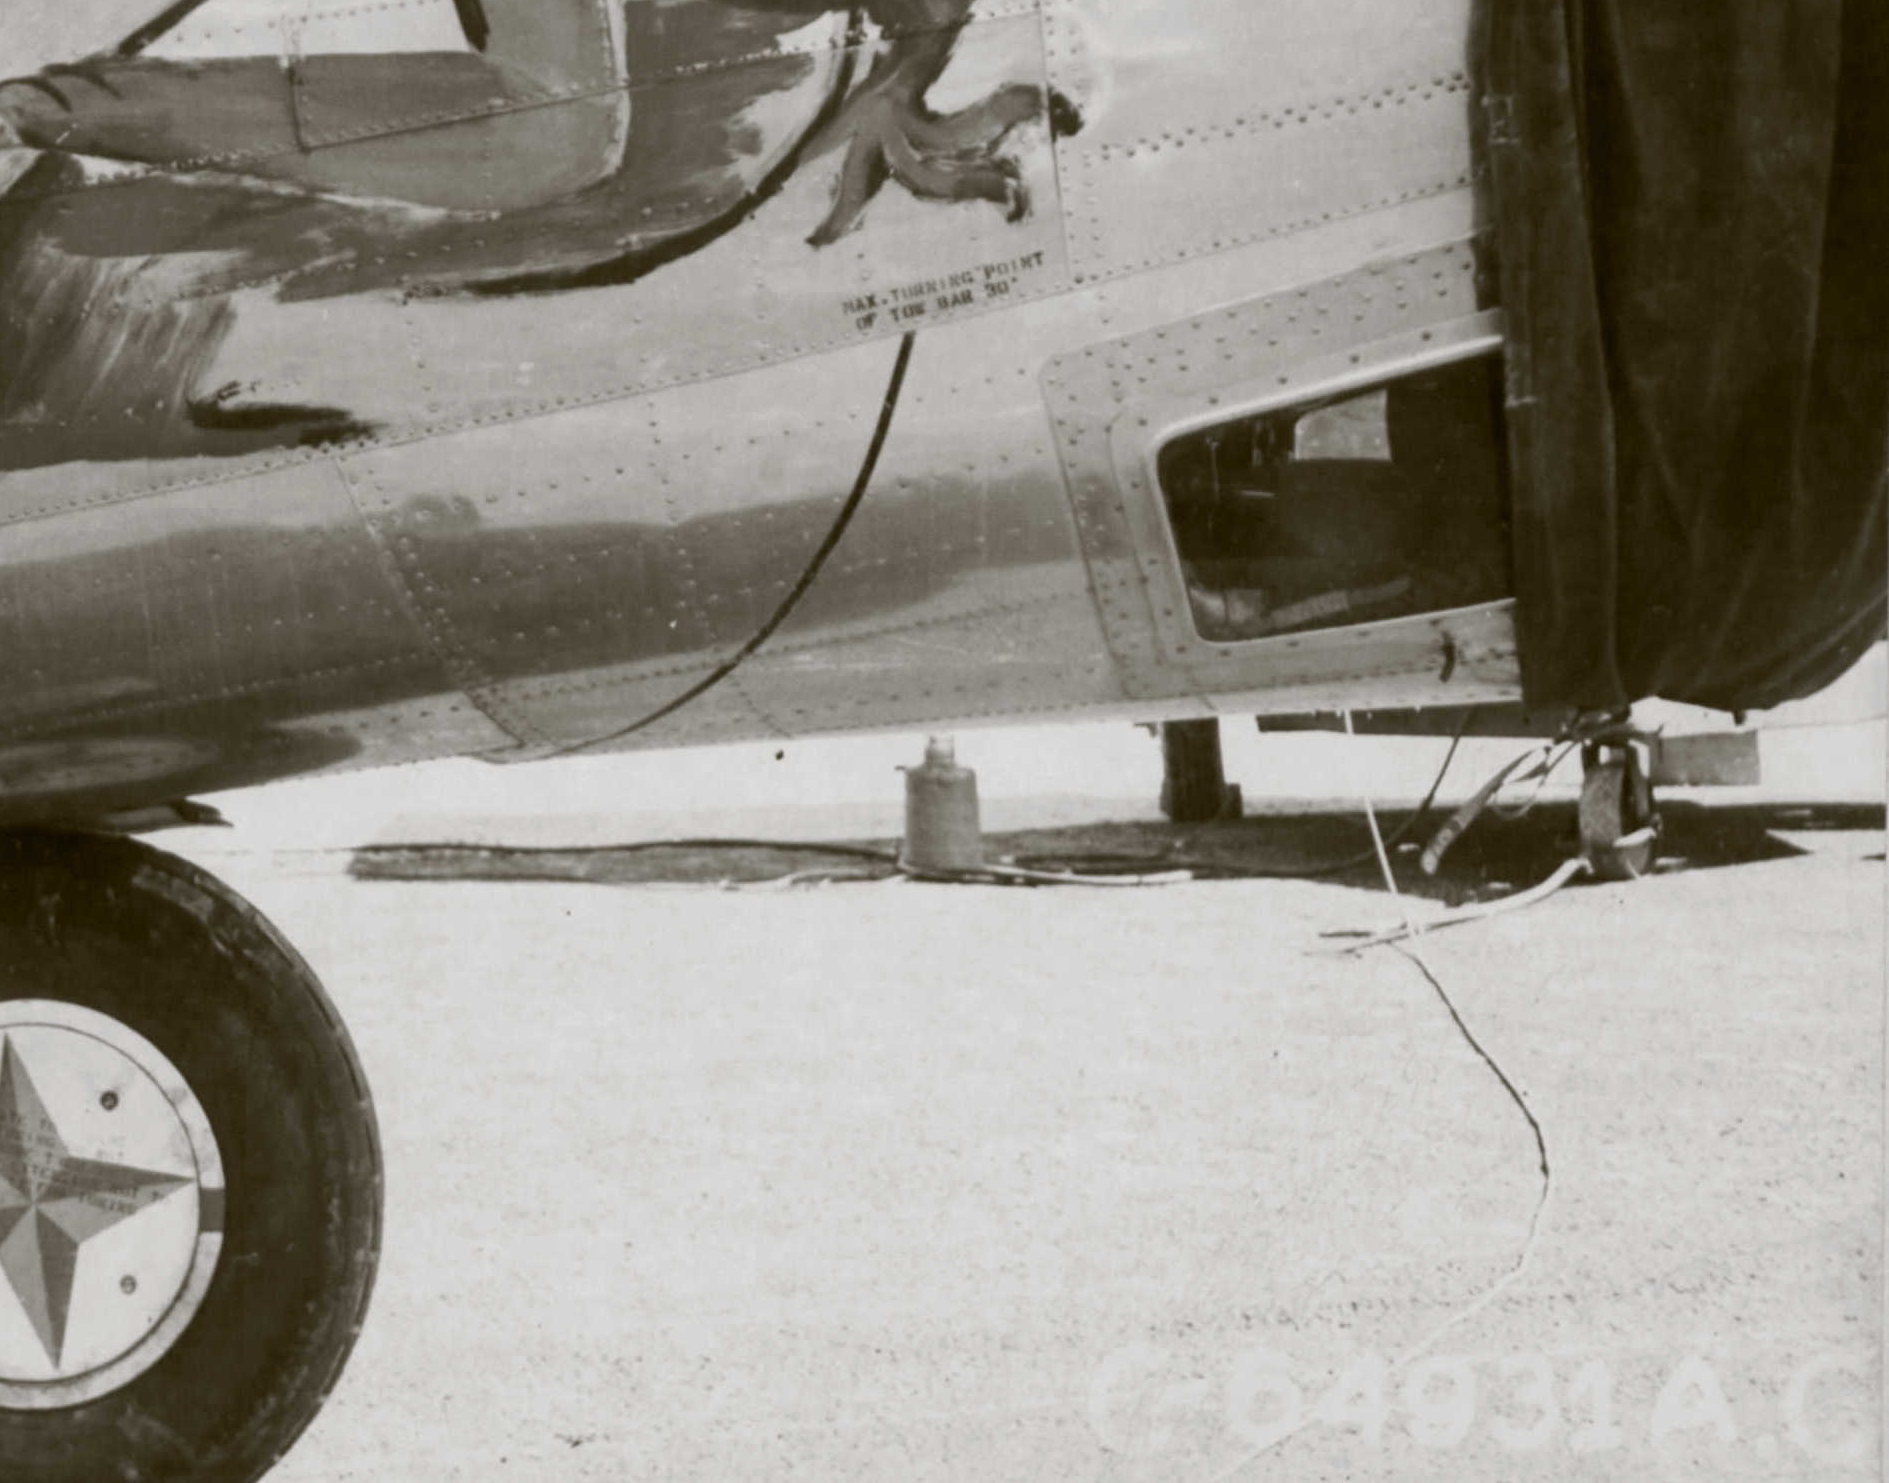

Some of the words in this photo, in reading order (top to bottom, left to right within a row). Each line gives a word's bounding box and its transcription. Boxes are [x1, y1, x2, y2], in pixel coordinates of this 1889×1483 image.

[984, 251, 1044, 279] POINT
[890, 301, 926, 323] TOW
[936, 288, 974, 312] BAR
